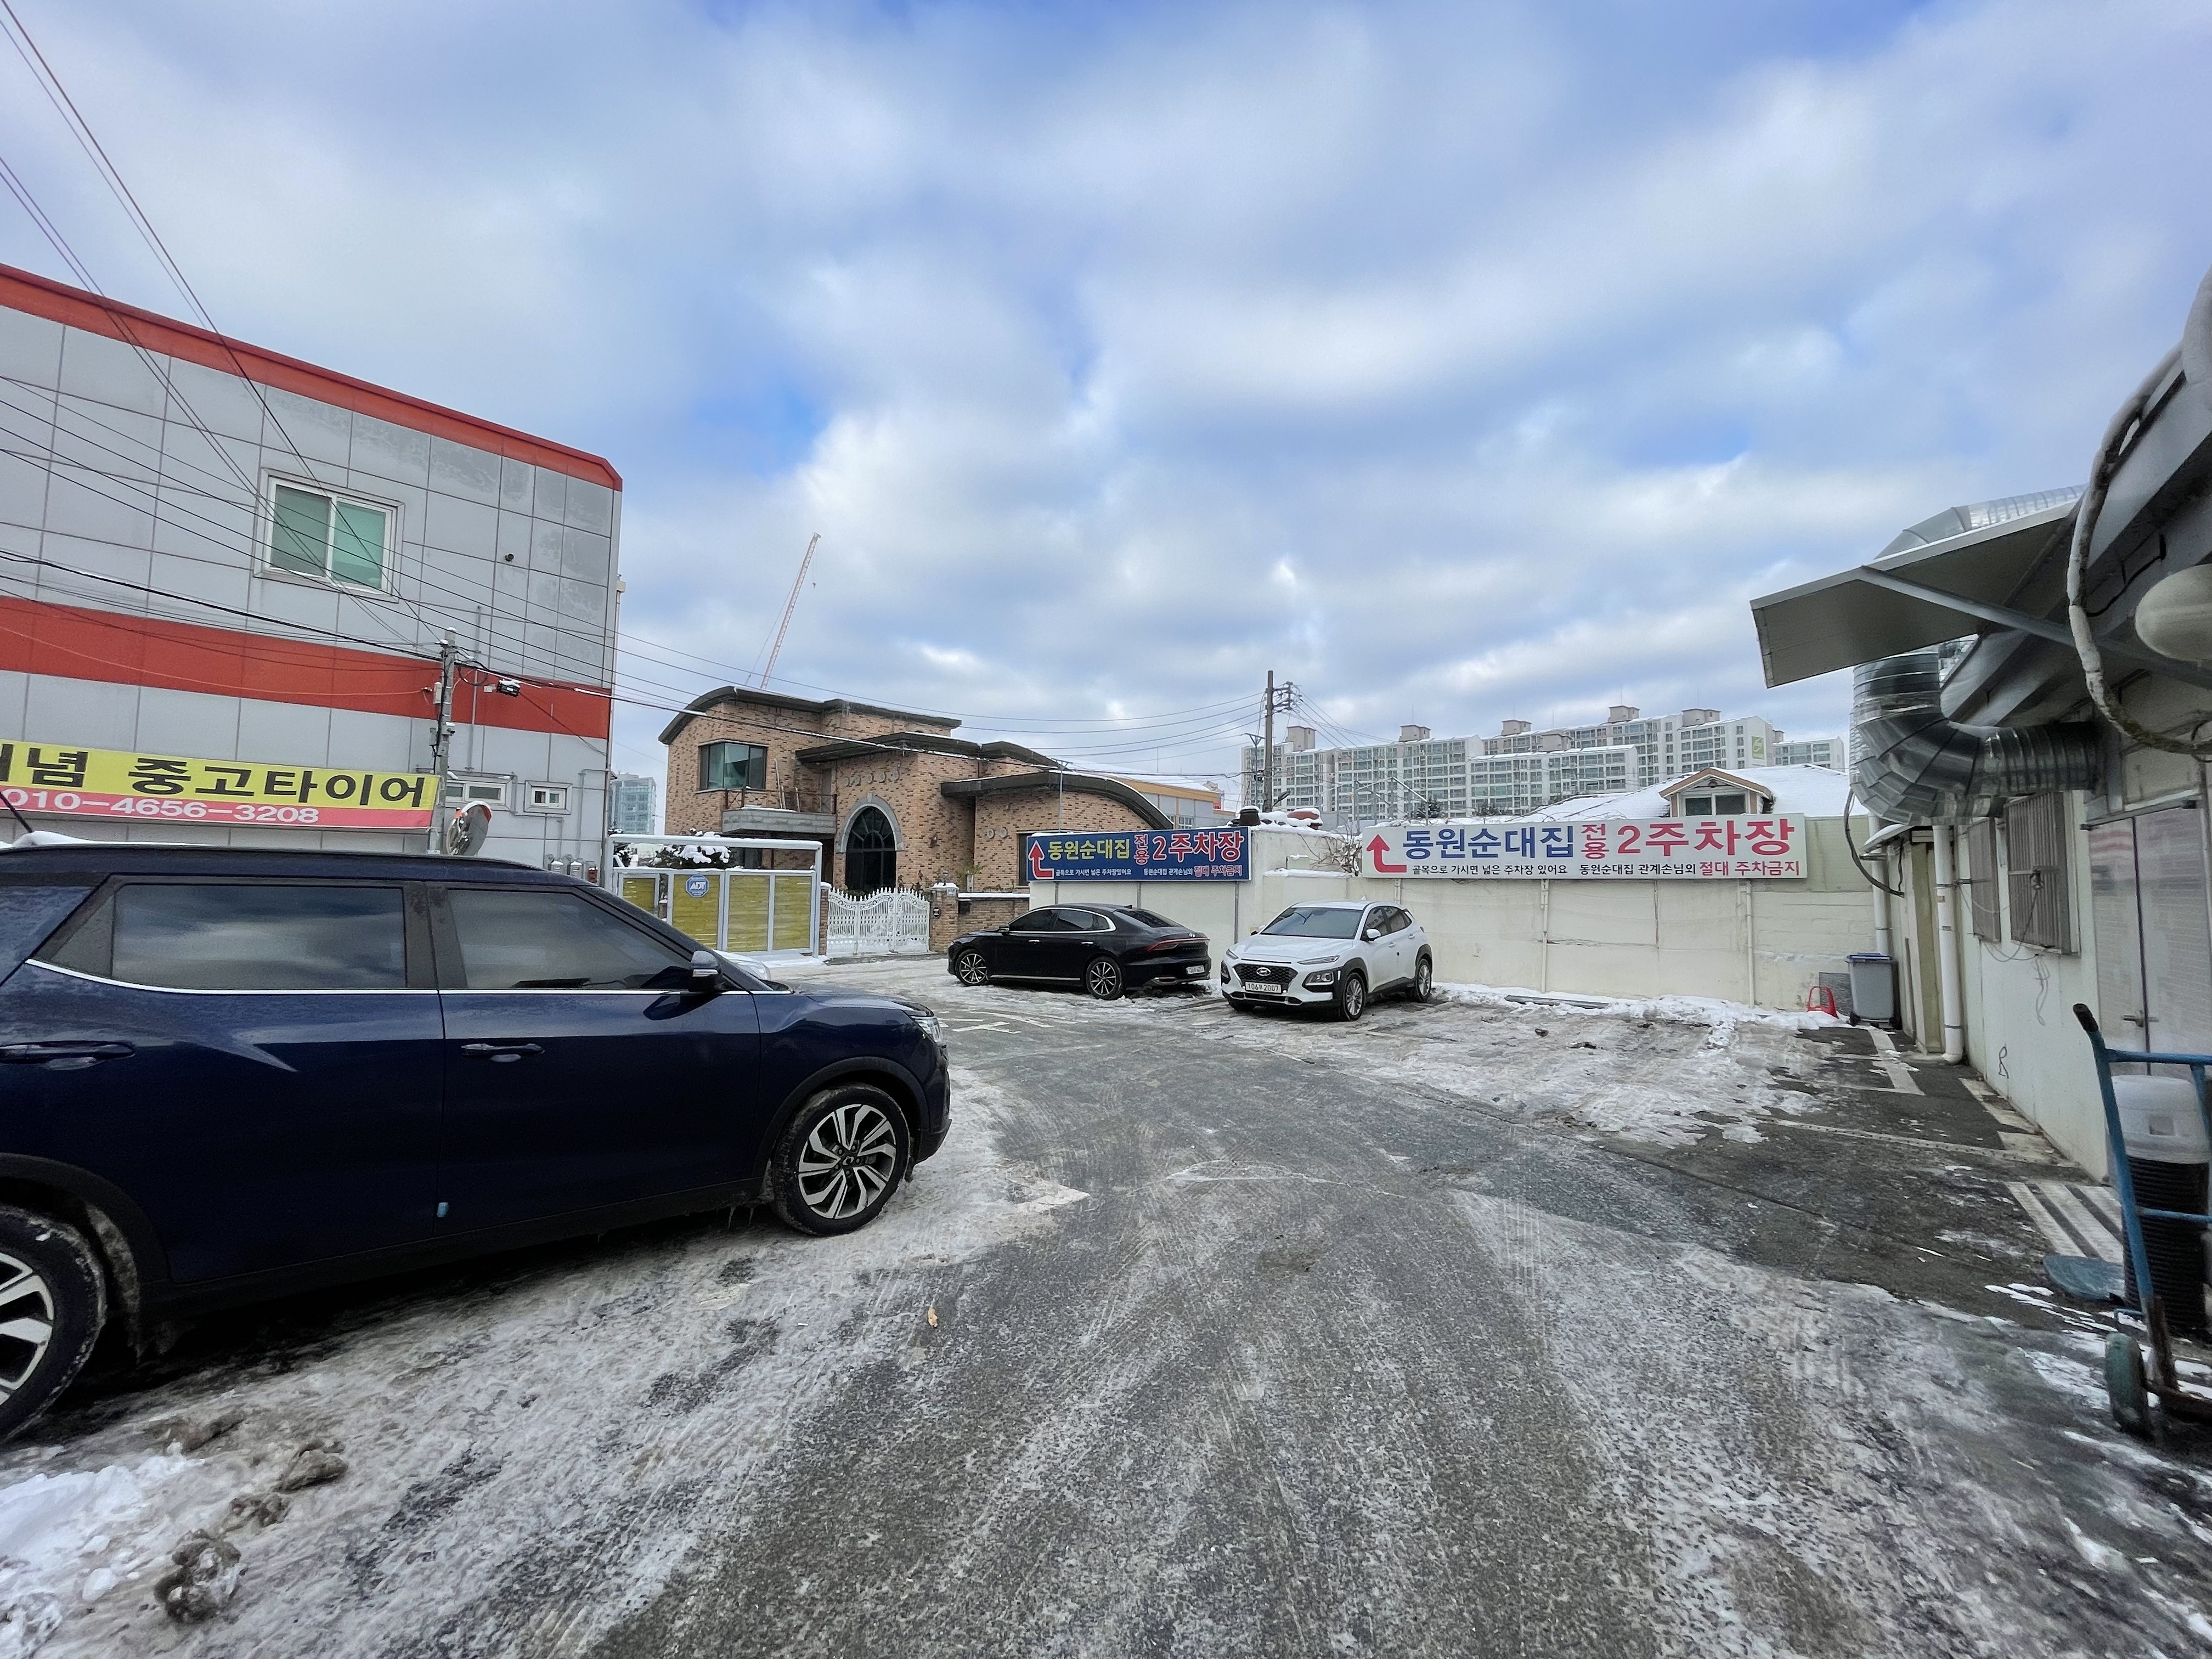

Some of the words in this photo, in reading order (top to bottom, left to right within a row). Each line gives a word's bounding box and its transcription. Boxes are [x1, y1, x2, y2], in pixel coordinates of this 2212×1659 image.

[128, 758, 425, 807] 중고타이어
[1, 788, 319, 823] 010-4656-3208
[1048, 839, 1130, 860] 동원순대집
[1133, 833, 1150, 865] 전용
[1403, 826, 1573, 860] 동원순대집
[1581, 823, 1610, 860] 전용
[1194, 865, 1210, 877] 절대
[1211, 865, 1243, 877] 주차금지
[1412, 865, 1448, 875] 골목으로
[1452, 865, 1479, 874] 가시면
[1482, 865, 1501, 874] 넓은
[1504, 865, 1534, 875] 주차장
[1538, 865, 1568, 874] 있어요
[1579, 864, 1634, 875] 동원순대집
[1638, 864, 1696, 875] 관계손님외
[1699, 861, 1729, 876] 절대
[1735, 861, 1801, 876] 주차금지
[689, 881, 706, 890] ADT
